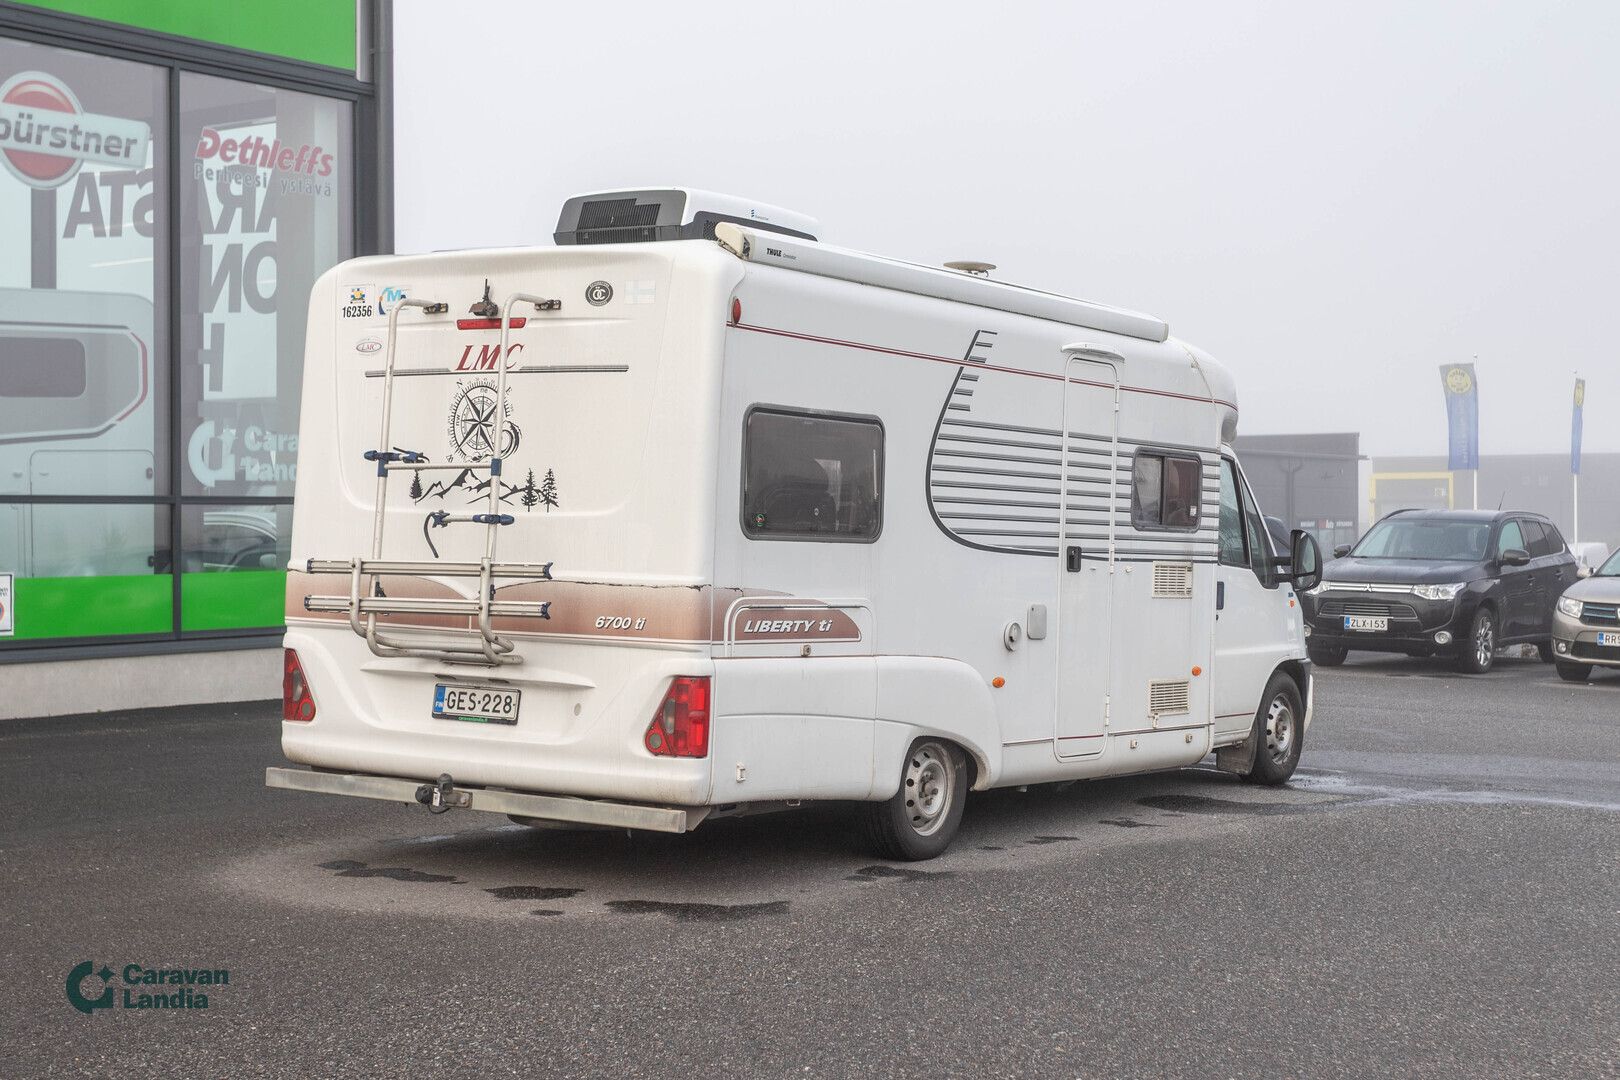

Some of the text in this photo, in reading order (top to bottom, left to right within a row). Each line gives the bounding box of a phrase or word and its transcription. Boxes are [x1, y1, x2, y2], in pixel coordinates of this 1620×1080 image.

[196, 128, 334, 176] Dethleffs
[766, 247, 782, 257] THULE
[342, 305, 372, 318] 162356
[455, 343, 525, 371] LMC
[595, 616, 646, 630] 6700 ti
[743, 619, 833, 633] LIBERTY ti
[1350, 619, 1386, 629] ZLX-153
[446, 690, 513, 714] GES-228
